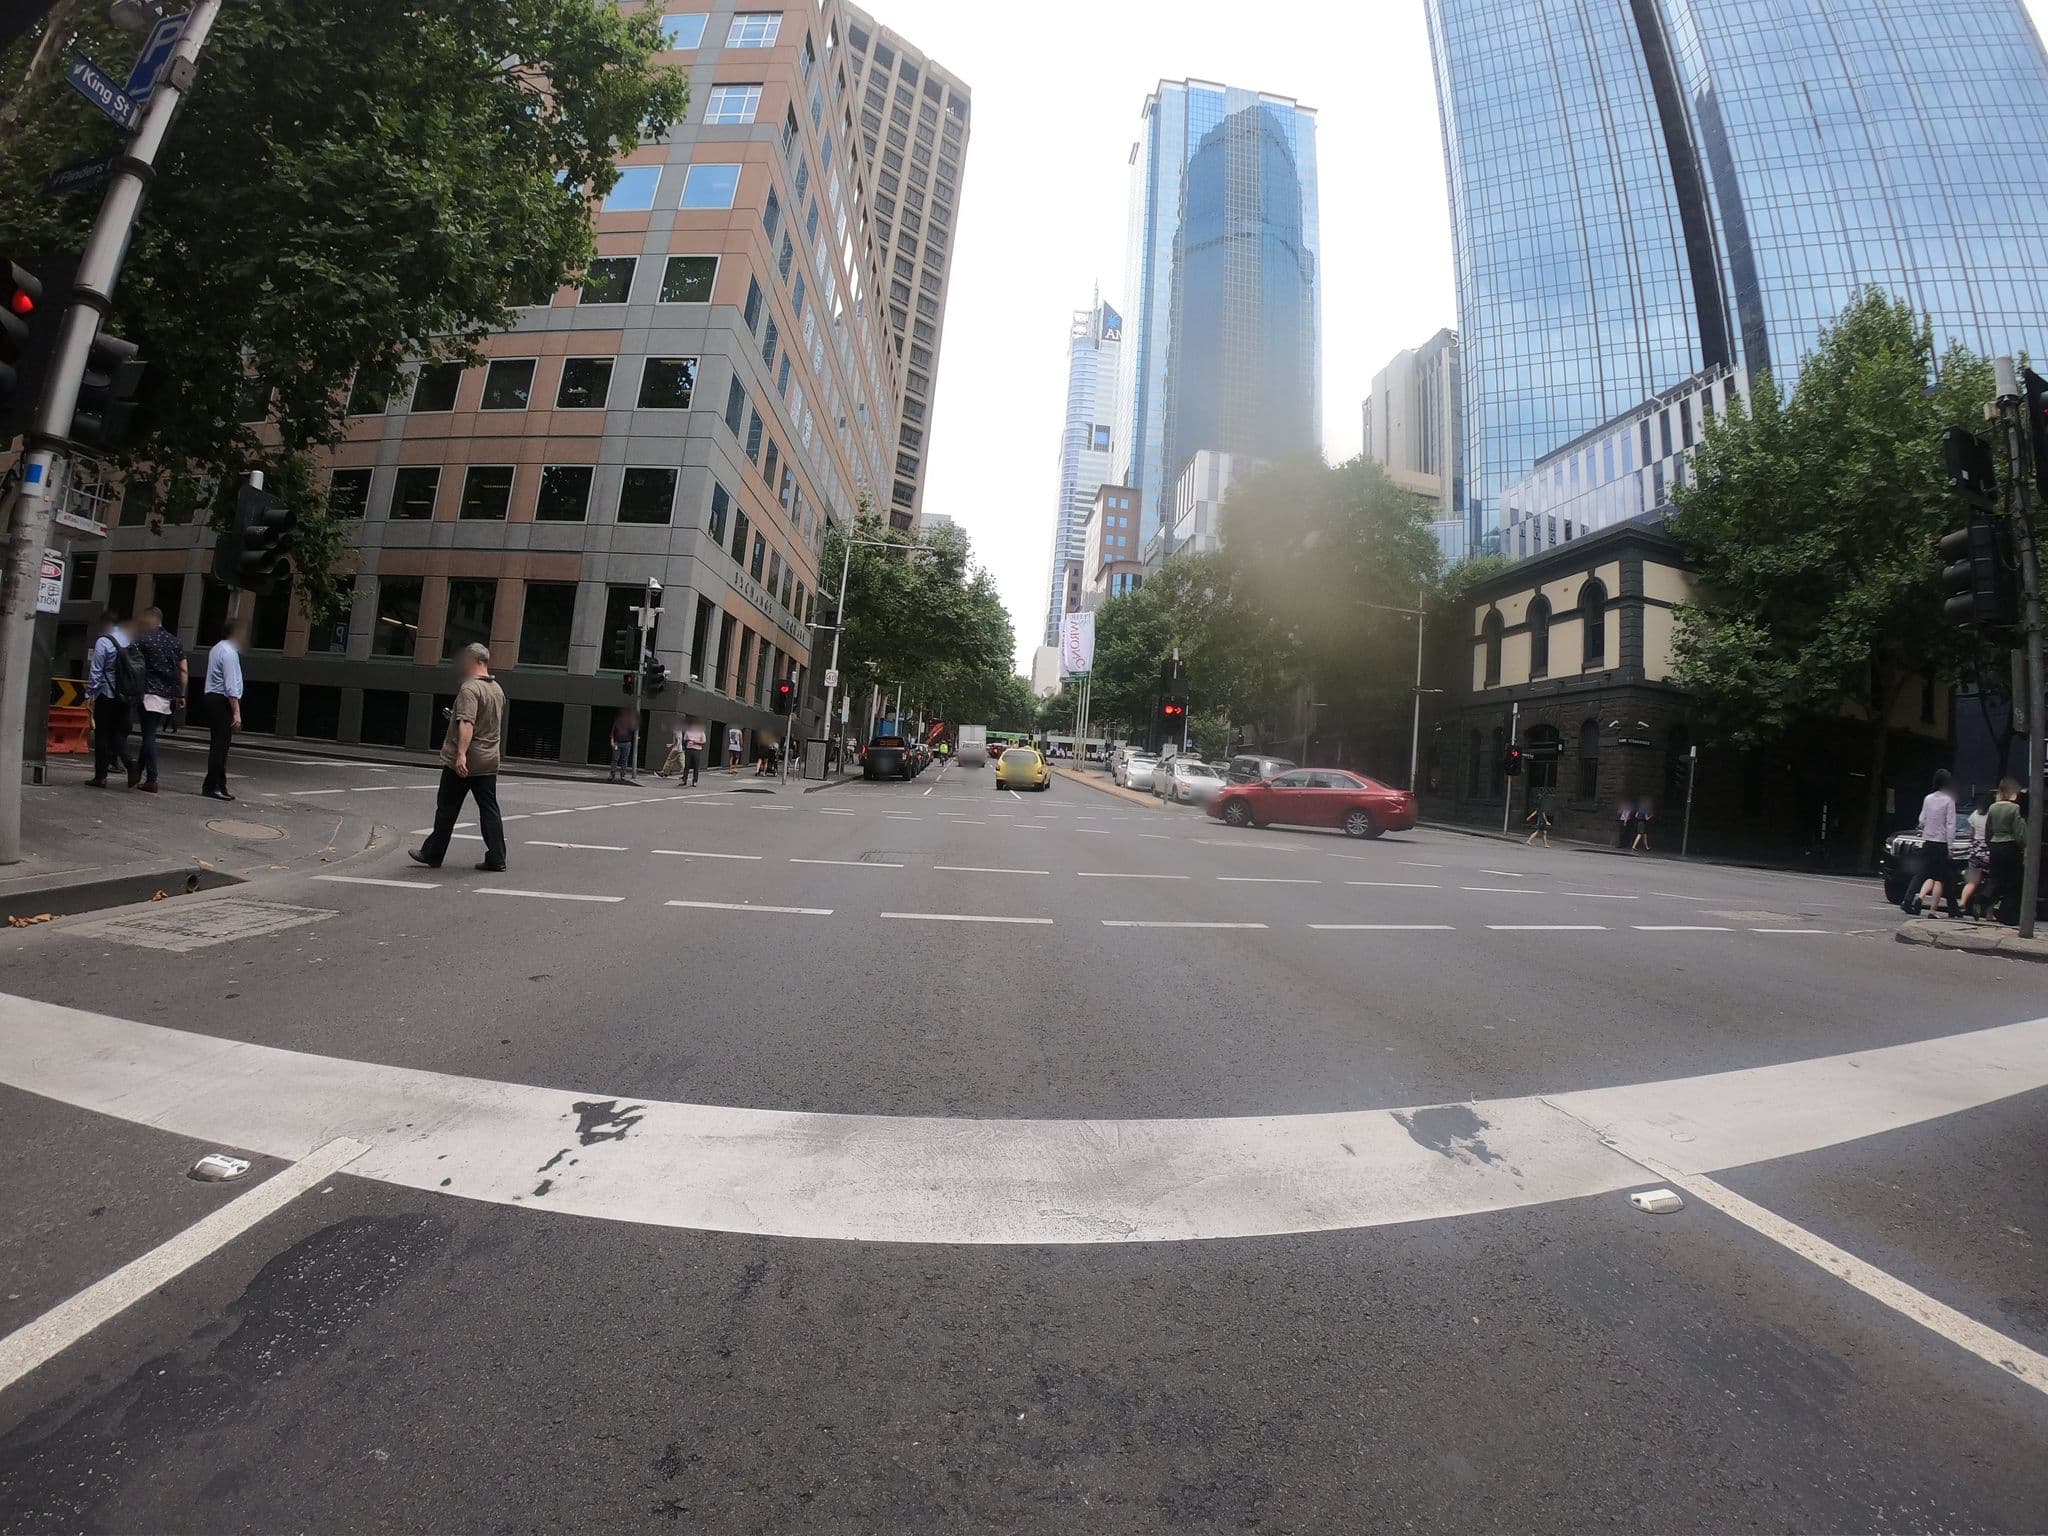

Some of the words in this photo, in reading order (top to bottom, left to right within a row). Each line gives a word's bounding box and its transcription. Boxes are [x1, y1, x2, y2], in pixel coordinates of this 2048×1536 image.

[143, 20, 185, 64] P
[82, 67, 113, 105] King
[114, 95, 131, 117] St
